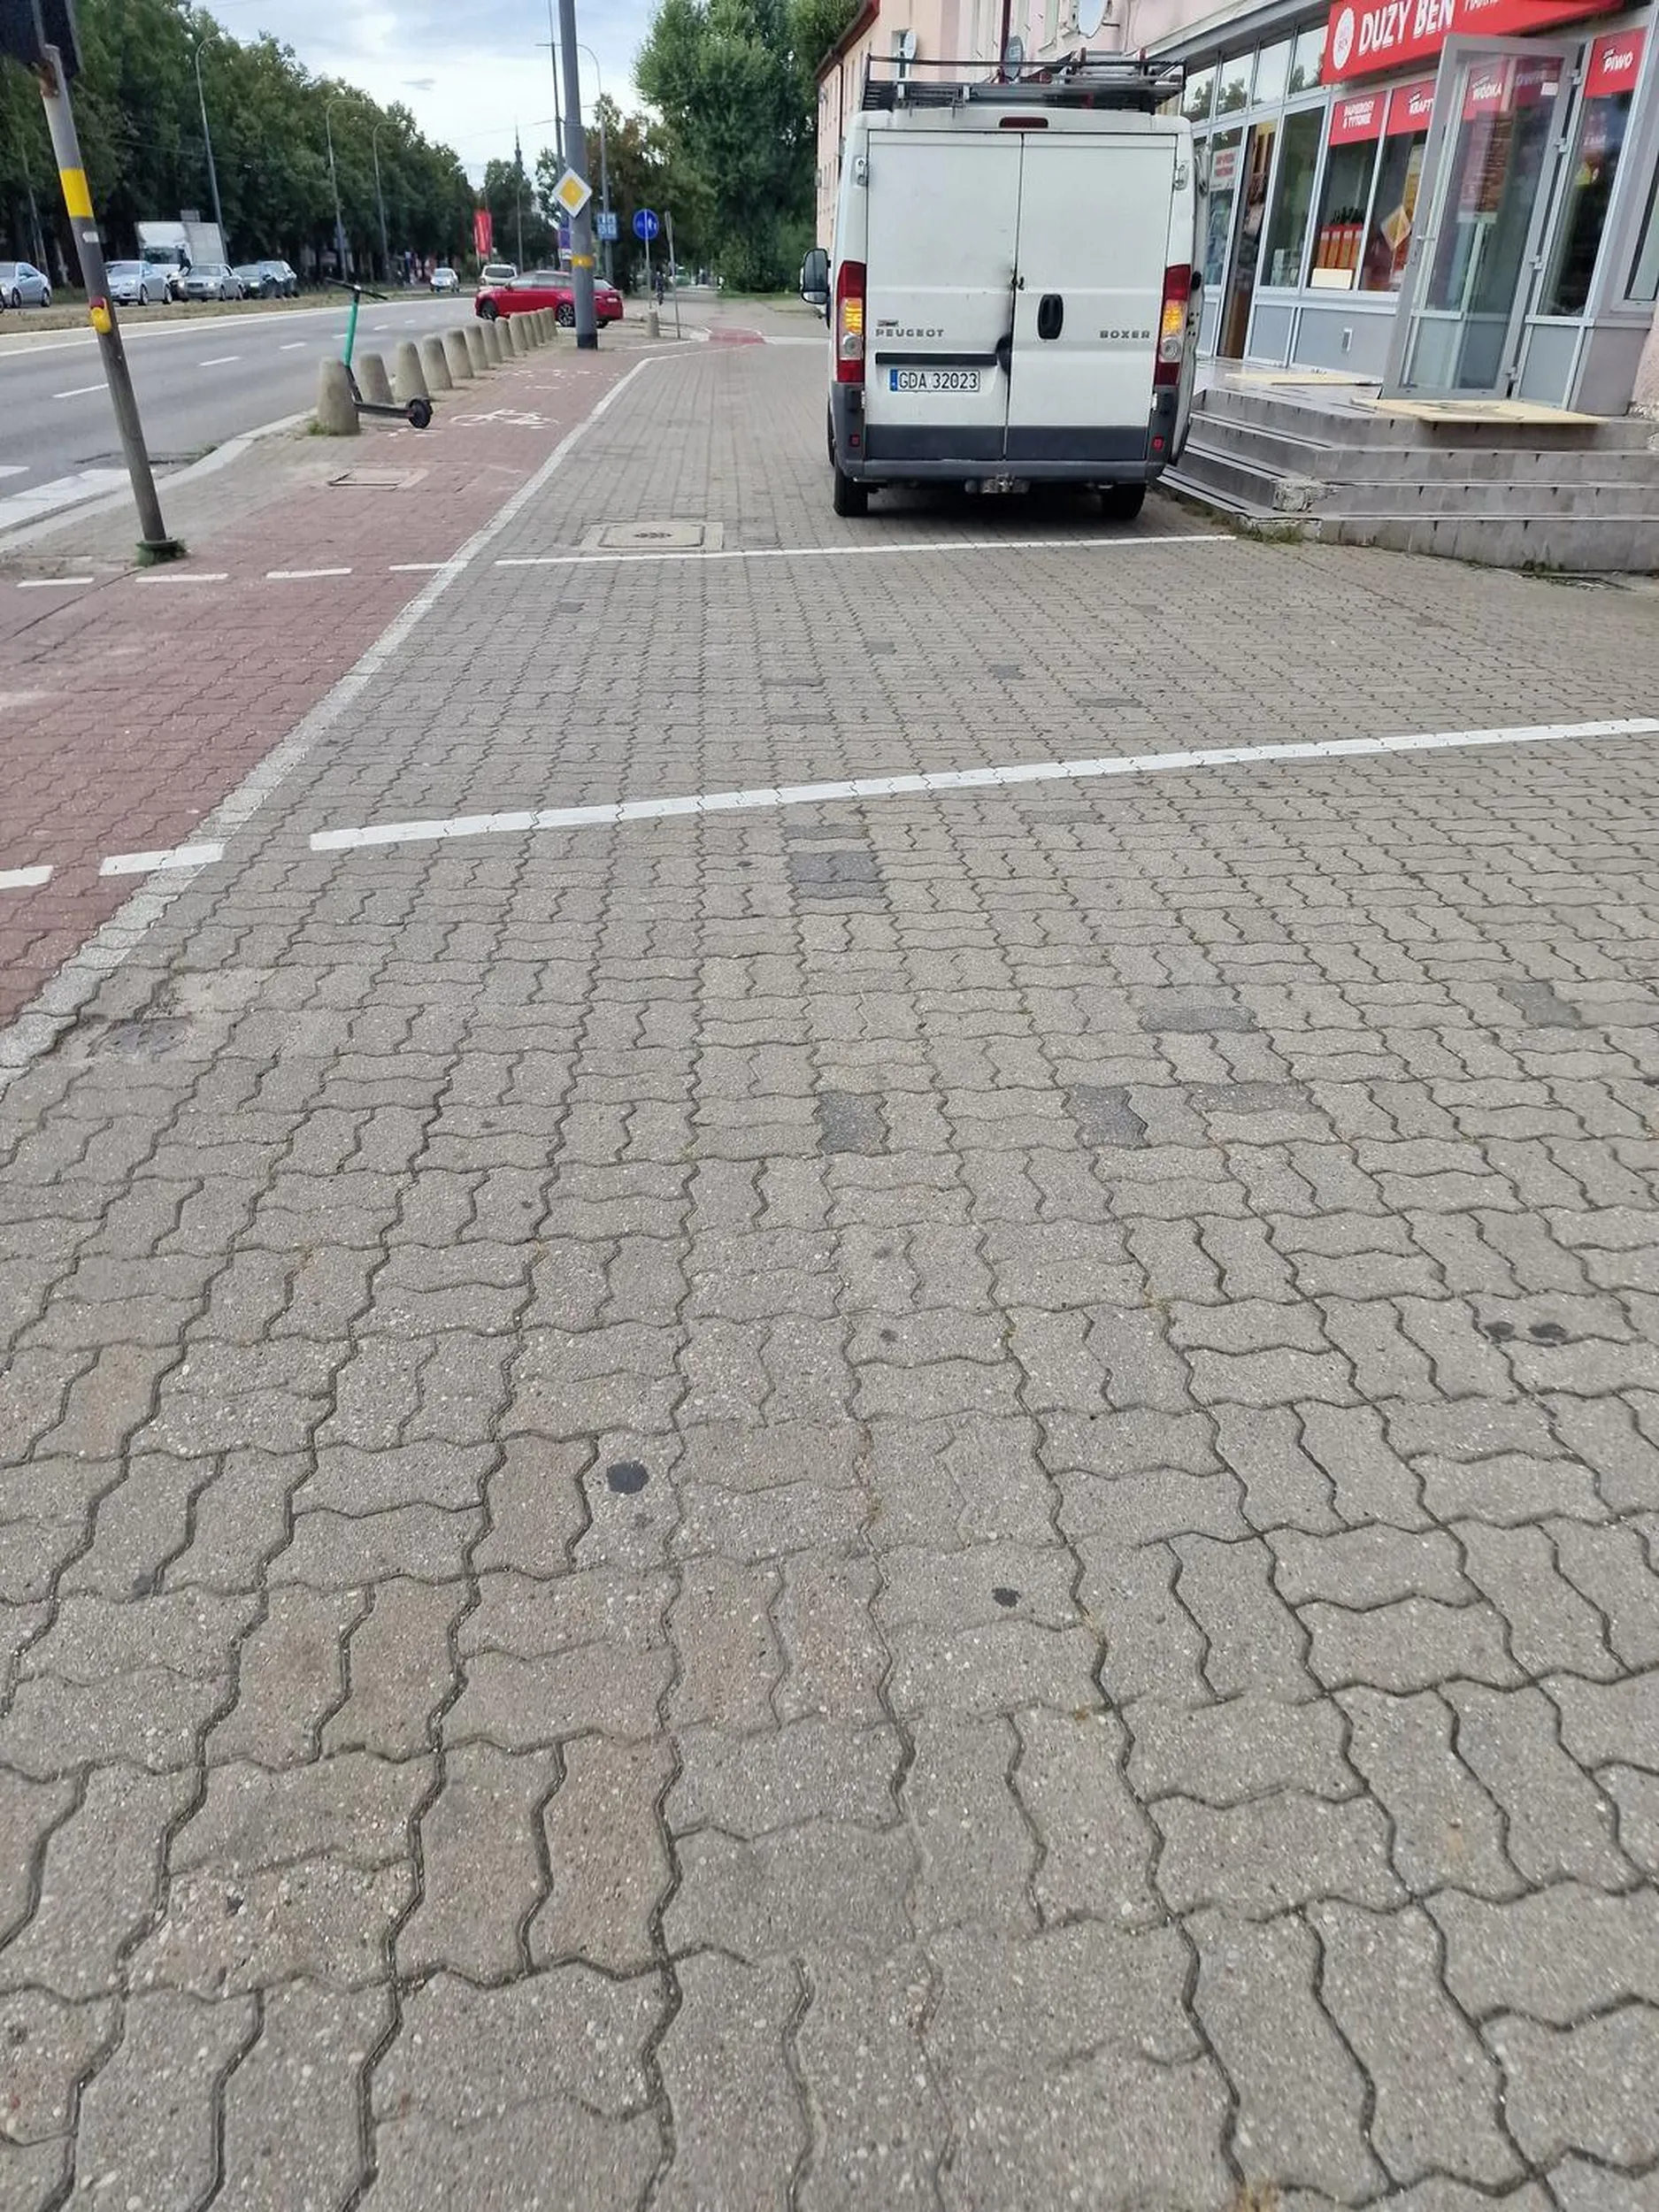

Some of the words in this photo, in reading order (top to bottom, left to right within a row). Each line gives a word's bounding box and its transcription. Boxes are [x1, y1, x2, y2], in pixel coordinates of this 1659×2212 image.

[1413, 0, 1455, 39] BEN
[1603, 50, 1634, 73] PIWO
[876, 328, 944, 337] PEUGEOT
[1100, 330, 1150, 339] BOXER
[899, 372, 927, 389] GDA
[933, 372, 978, 389] 32023
